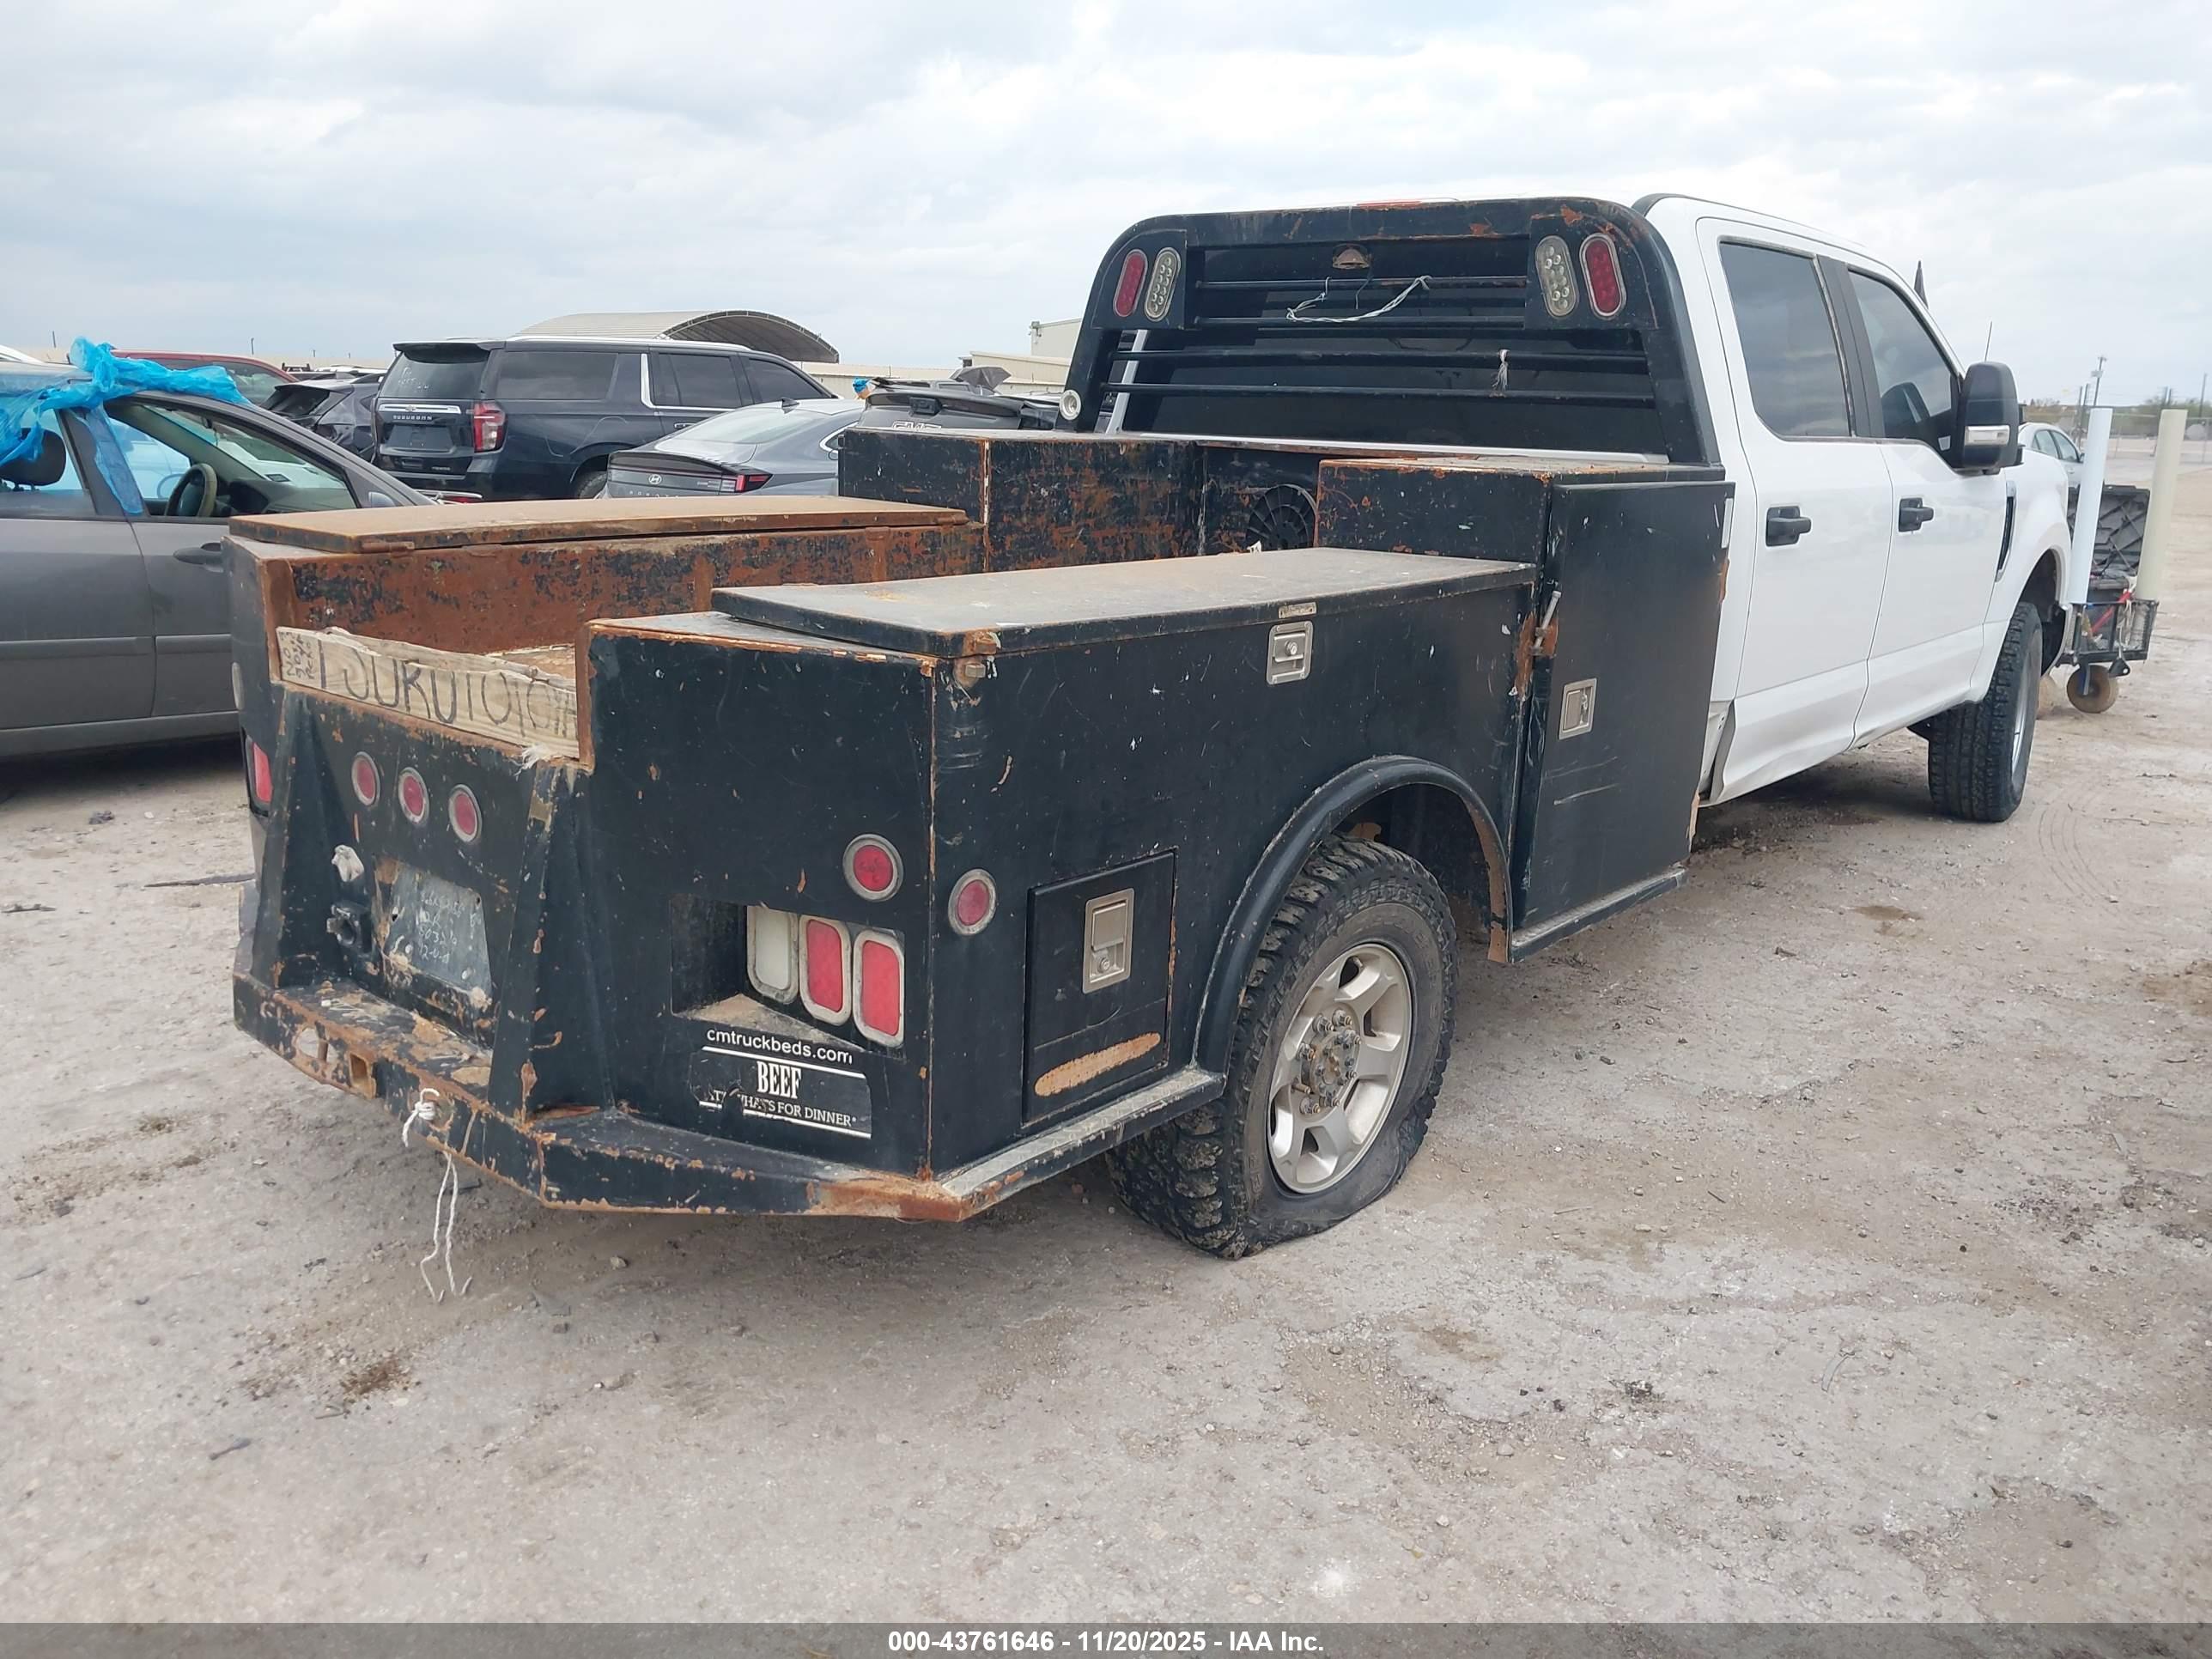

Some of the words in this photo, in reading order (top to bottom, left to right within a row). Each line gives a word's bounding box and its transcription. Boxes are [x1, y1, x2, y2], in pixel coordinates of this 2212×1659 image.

[707, 1029, 853, 1065] cmtruckbeds.com
[757, 1060, 802, 1100] BEEF
[777, 1102, 802, 1118] FOR
